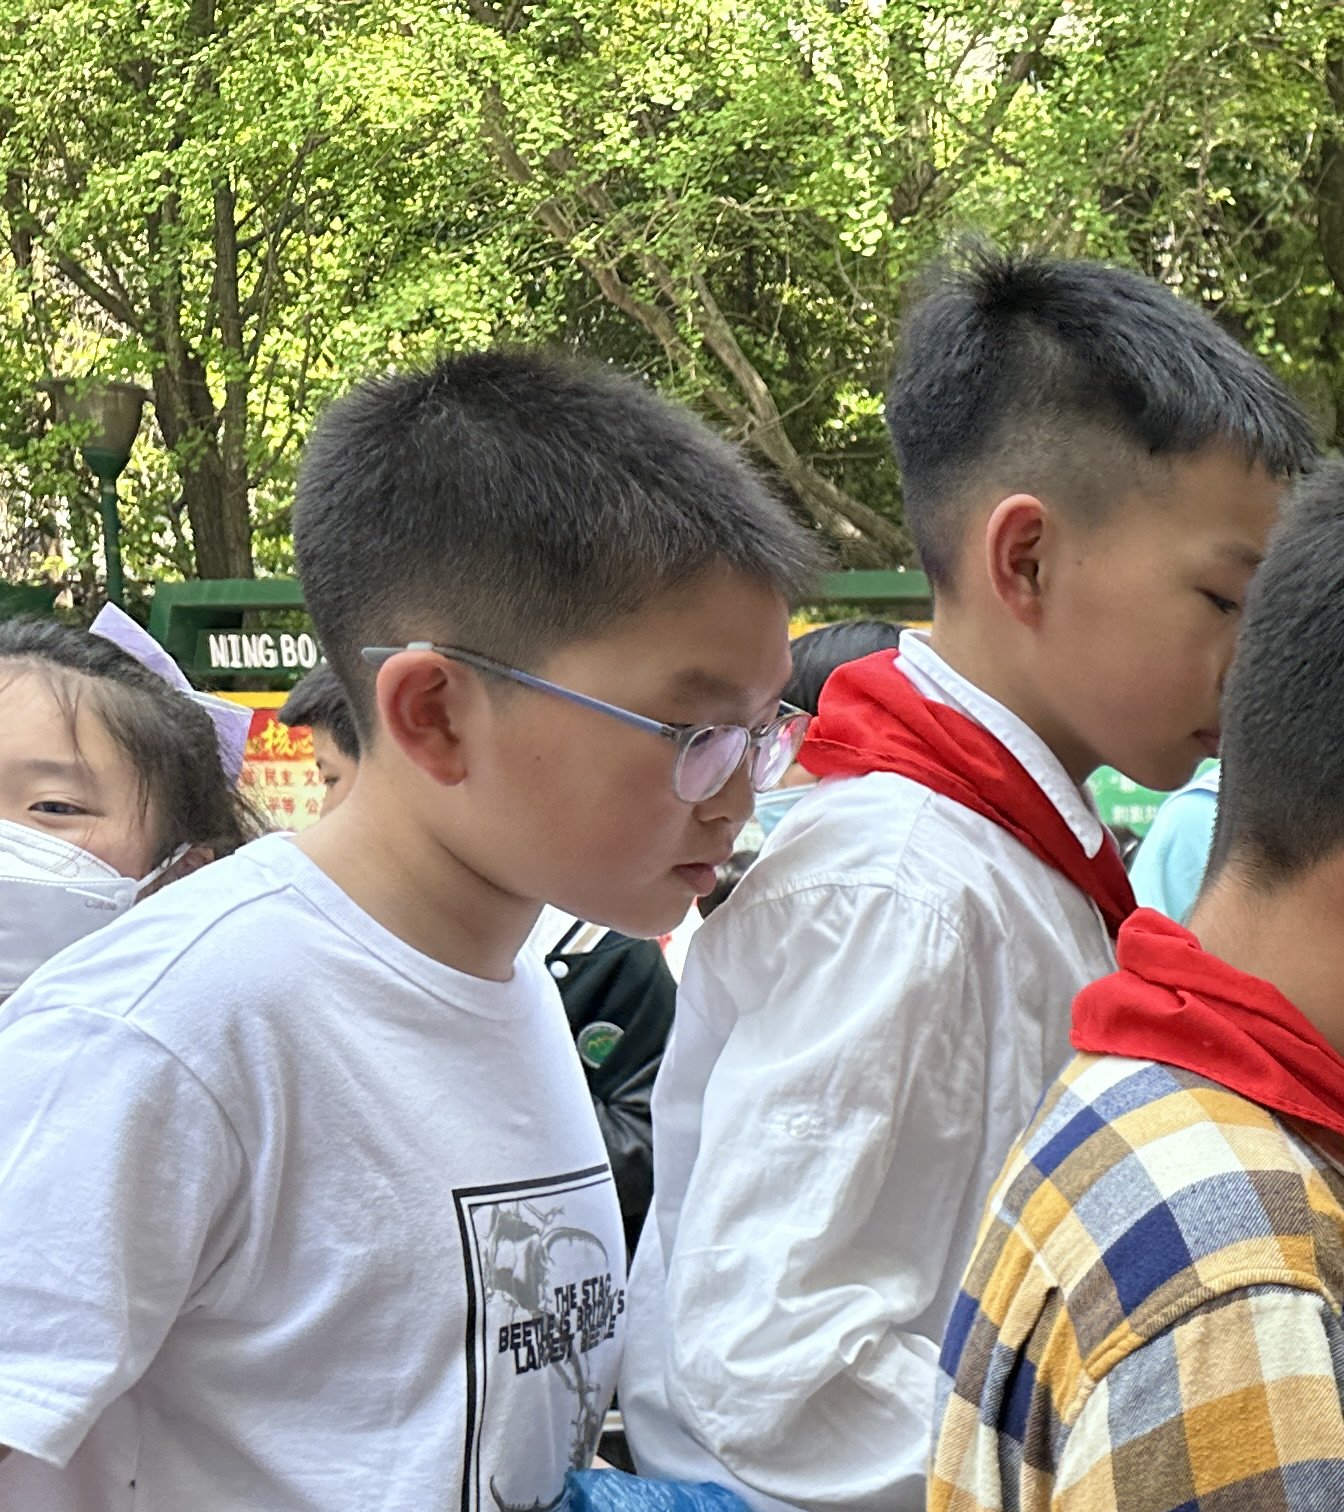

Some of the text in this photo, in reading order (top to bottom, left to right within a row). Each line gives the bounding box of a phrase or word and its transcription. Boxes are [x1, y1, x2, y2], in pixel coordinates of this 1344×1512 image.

[209, 633, 318, 669] NING BO
[554, 1283, 577, 1313] THE
